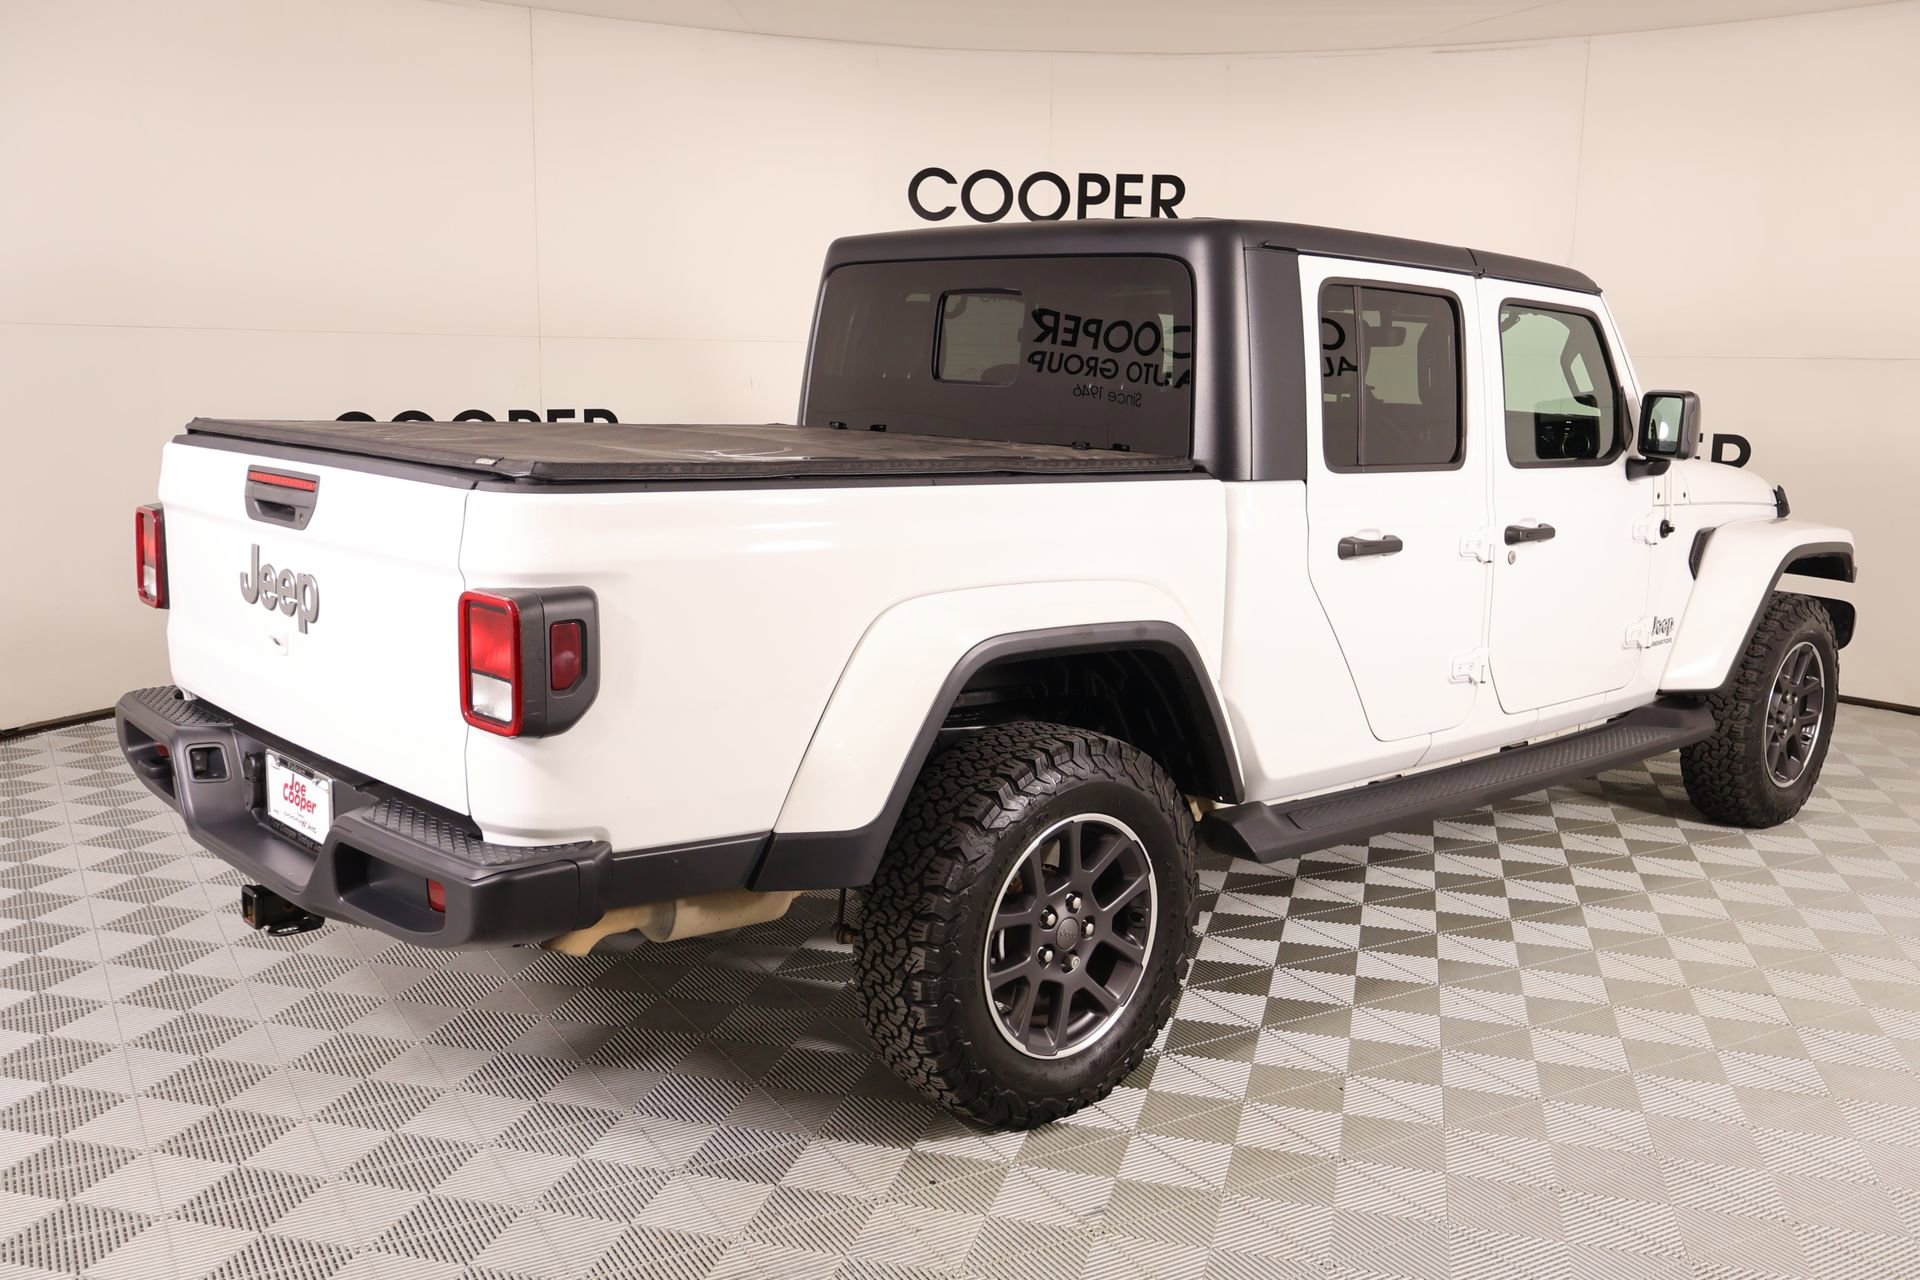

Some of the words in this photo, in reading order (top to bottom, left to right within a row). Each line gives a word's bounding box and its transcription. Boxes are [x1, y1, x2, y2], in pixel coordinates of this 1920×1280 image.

[908, 167, 1186, 222] COOPER
[239, 543, 320, 635] Jeep
[1651, 616, 1674, 637] Jeep
[282, 782, 317, 814] Cooper
[289, 773, 307, 796] Joe
